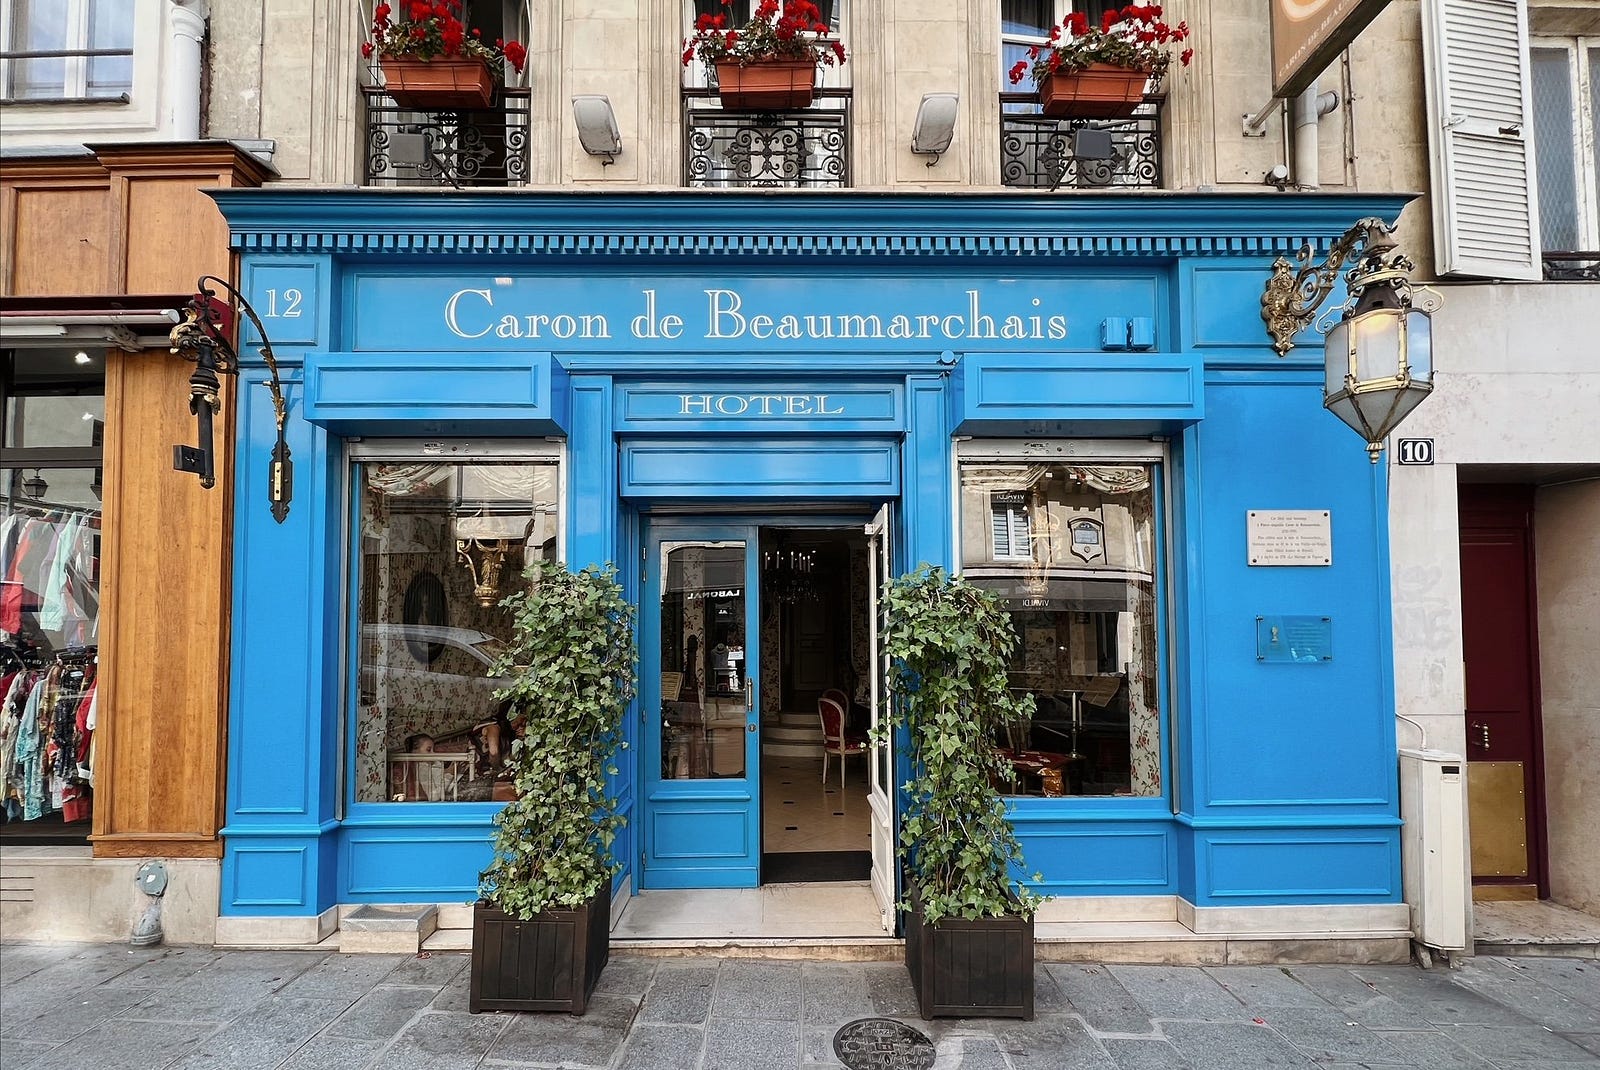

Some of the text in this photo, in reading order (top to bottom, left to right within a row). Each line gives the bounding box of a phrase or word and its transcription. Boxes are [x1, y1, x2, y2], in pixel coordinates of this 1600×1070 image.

[1279, 43, 1307, 77] CARON
[1307, 27, 1320, 45] DE
[264, 288, 303, 319] 12
[444, 287, 1068, 341] Caron de Beaumarchais
[677, 394, 845, 416] HOTEL
[1403, 441, 1429, 463] 10
